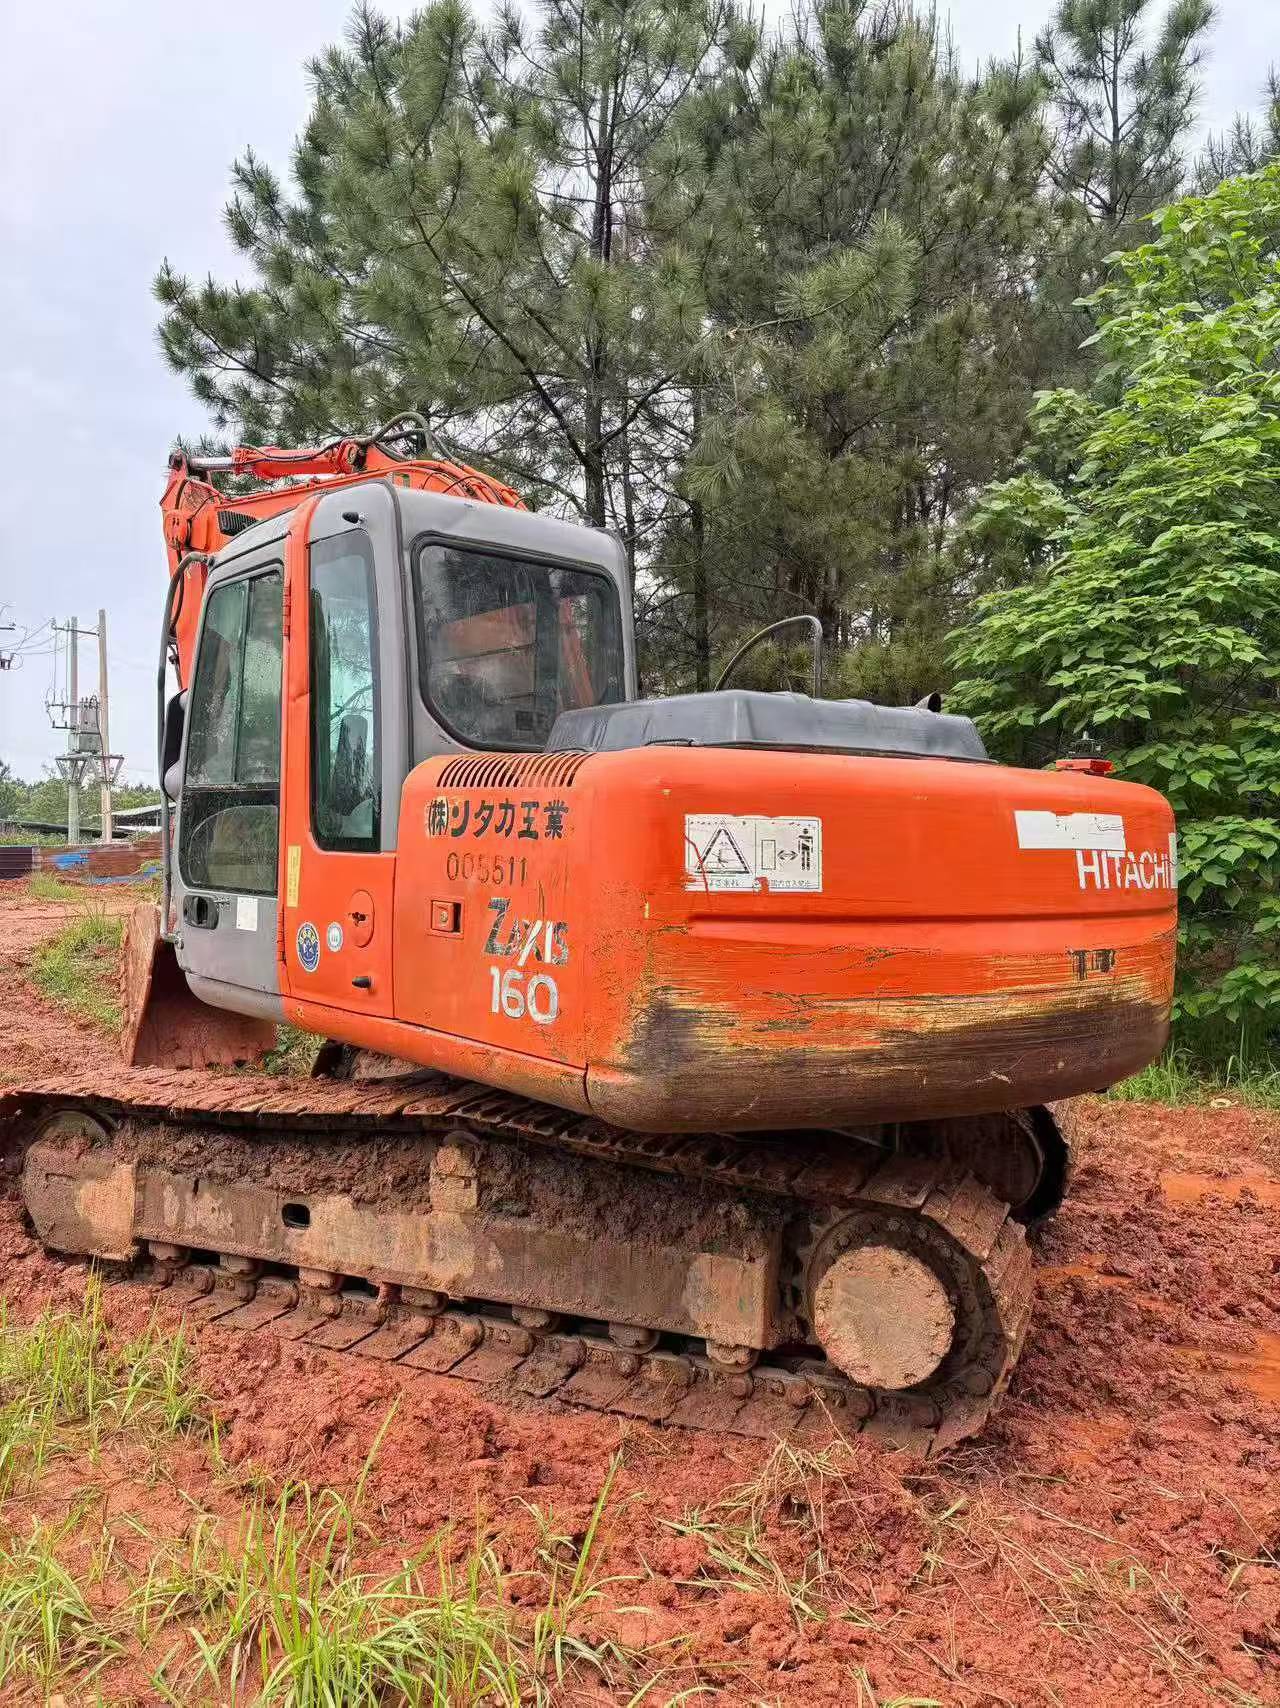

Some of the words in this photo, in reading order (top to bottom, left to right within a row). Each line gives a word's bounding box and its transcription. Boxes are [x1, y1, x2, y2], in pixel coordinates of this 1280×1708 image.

[446, 851, 527, 887] 005511
[1076, 849, 1169, 890] HITACHI
[490, 965, 560, 1026] 160
